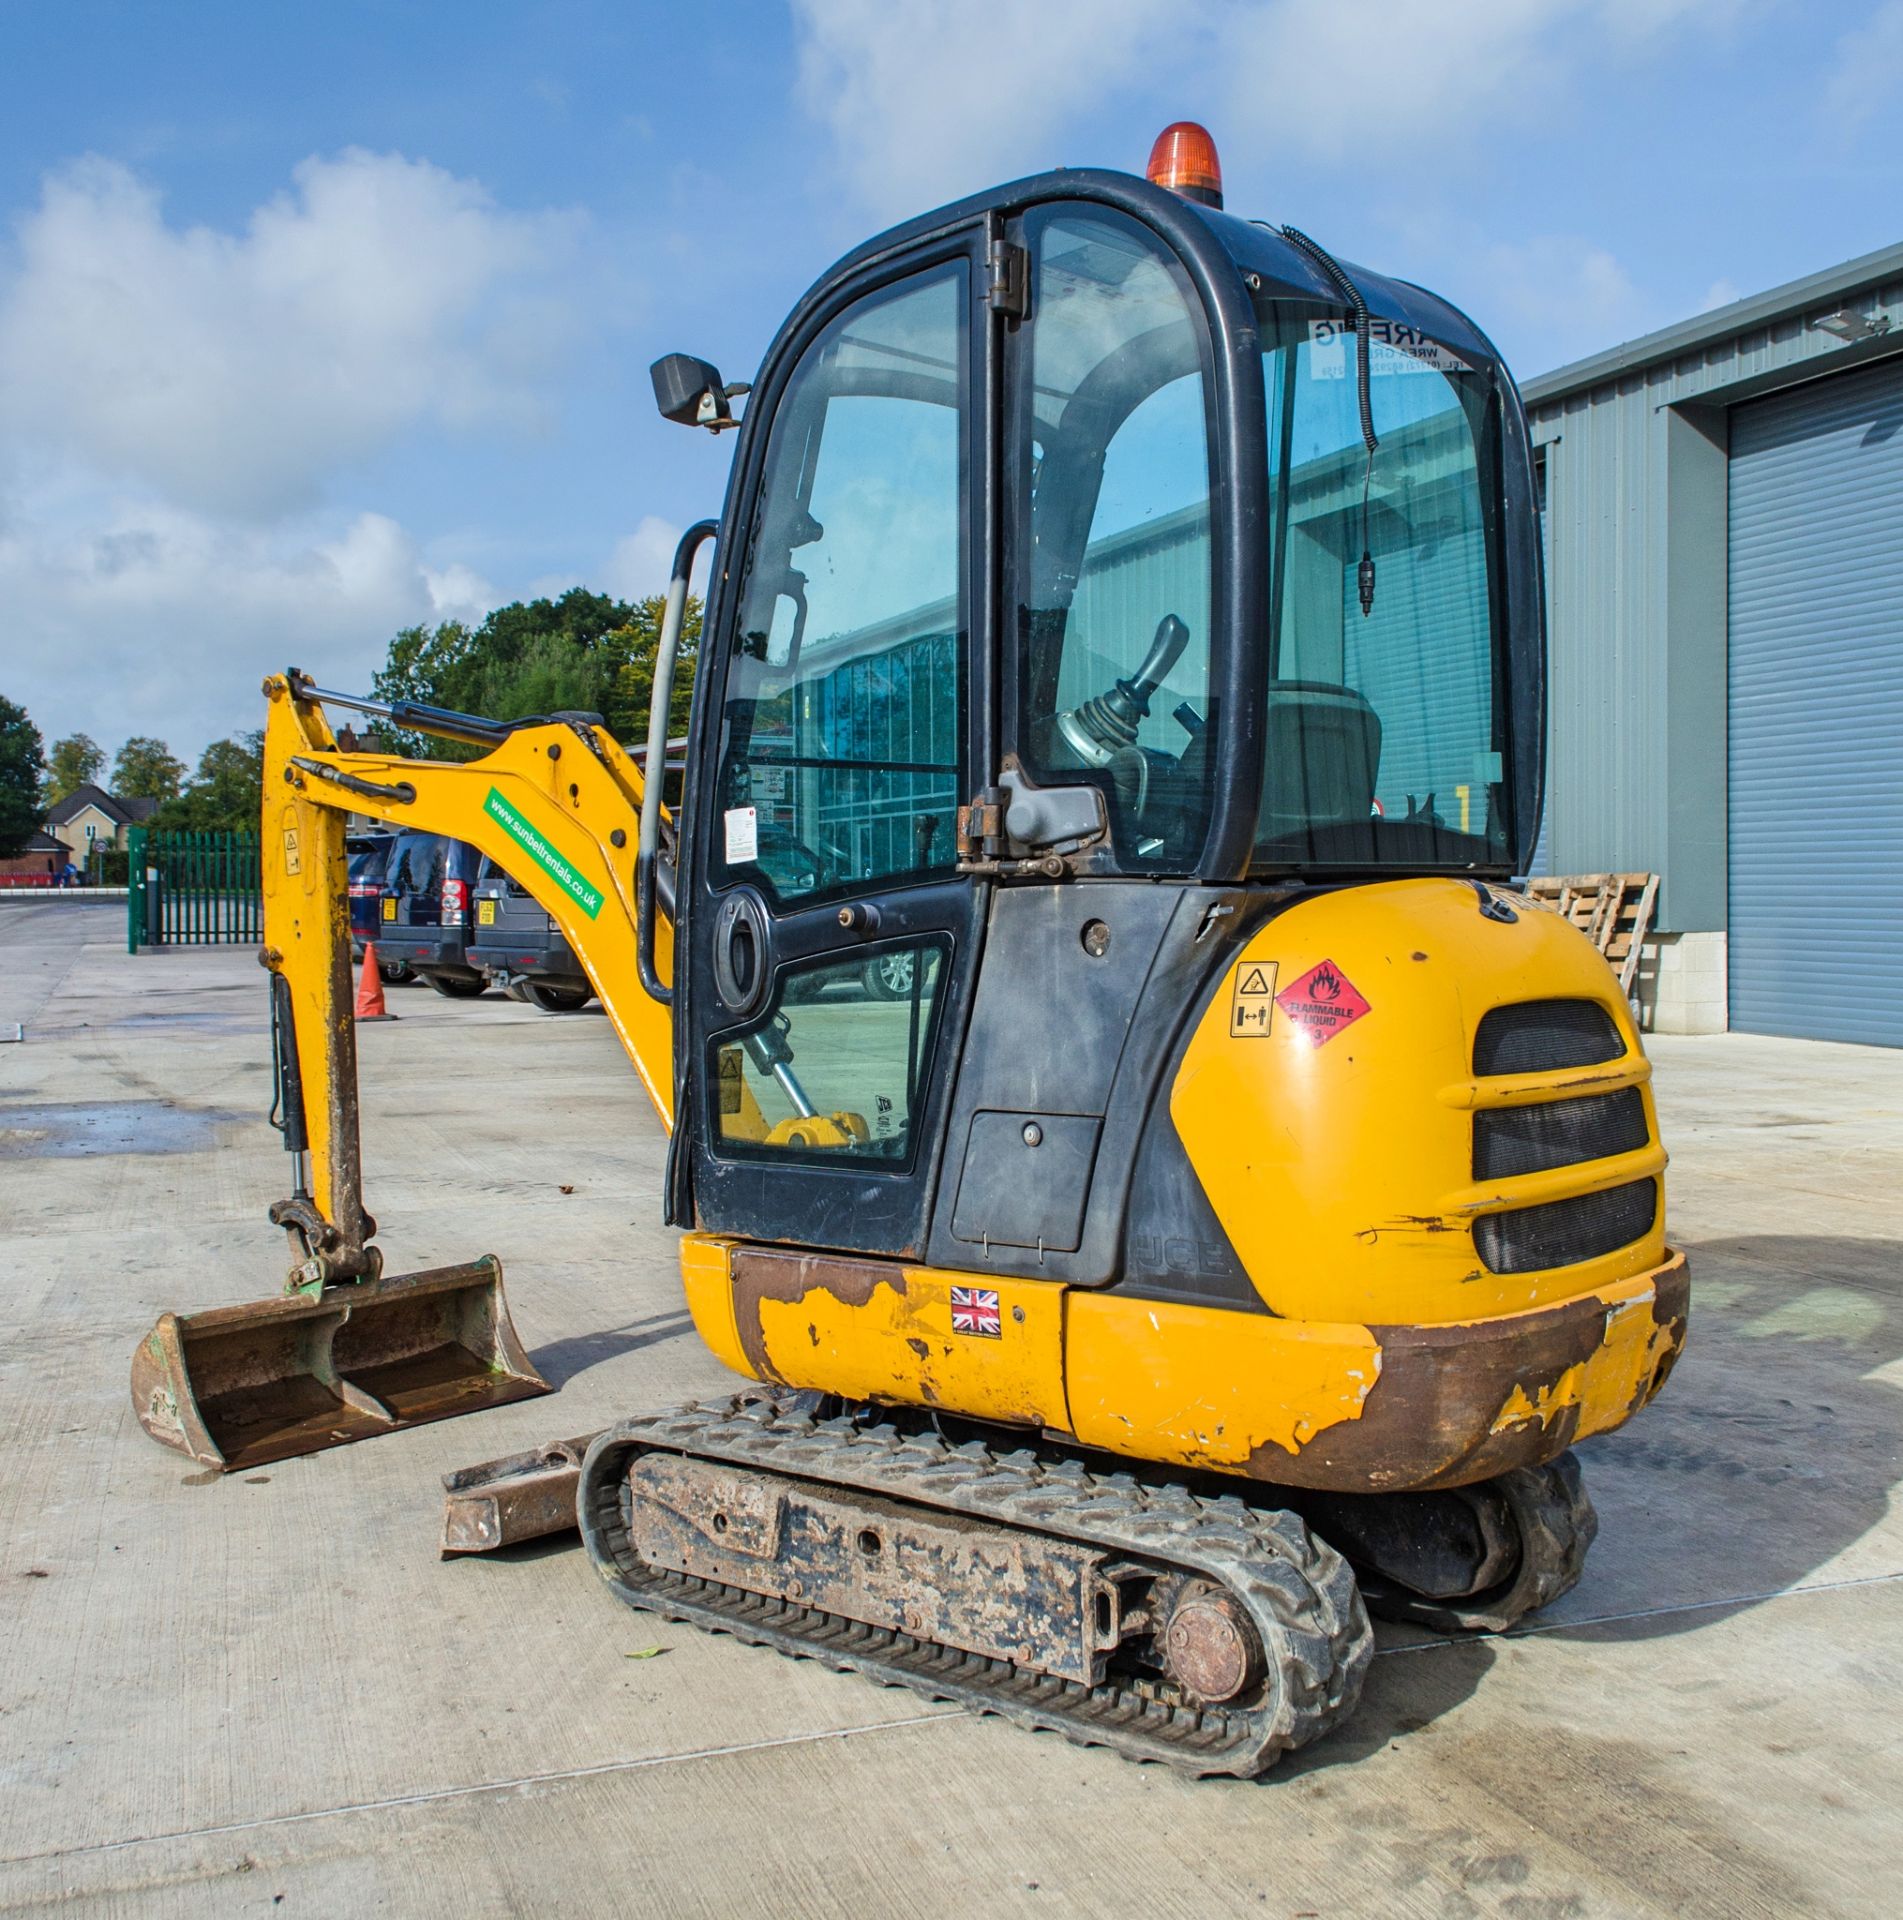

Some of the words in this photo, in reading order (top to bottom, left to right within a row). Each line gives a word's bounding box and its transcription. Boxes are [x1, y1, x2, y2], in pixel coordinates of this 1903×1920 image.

[490, 798, 598, 910] www.sunbeltrentals.co.uk
[1290, 1002, 1354, 1018] FLAMMABLE
[1304, 1013, 1337, 1026] LIQUID
[1314, 1029, 1322, 1039] 3
